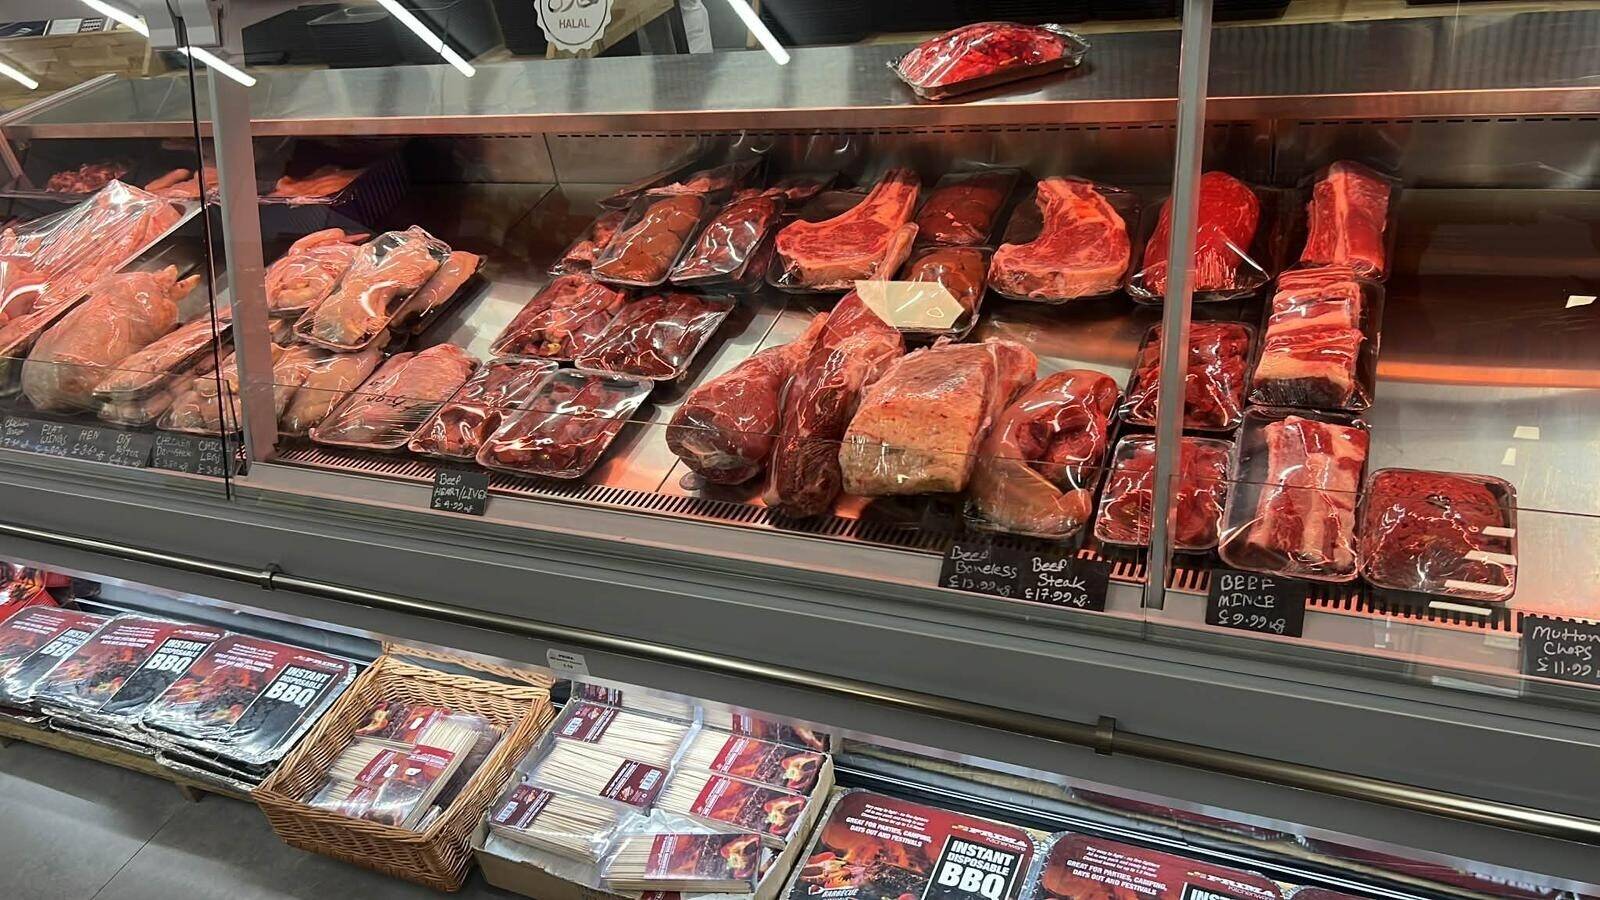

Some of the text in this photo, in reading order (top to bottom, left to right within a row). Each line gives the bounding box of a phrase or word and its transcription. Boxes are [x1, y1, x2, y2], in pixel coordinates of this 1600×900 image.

[560, 18, 590, 28] HALAL
[439, 473, 462, 485] Beef
[950, 545, 990, 561] Beef
[956, 560, 1018, 579] Boneless
[1032, 557, 1067, 573] Beef
[1037, 573, 1086, 592] Steak
[1220, 574, 1276, 591] BEEF
[1218, 593, 1275, 608] MINCE
[1532, 625, 1600, 643] Mutton
[164, 639, 208, 651] INSTANT
[1543, 641, 1592, 661] Chops
[144, 653, 193, 675] BBQ
[284, 666, 332, 682] INSTANT
[264, 681, 317, 708] BBQ
[846, 817, 865, 826] GREAT
[865, 820, 877, 829] FOR
[850, 824, 866, 833] DAYS
[877, 831, 891, 840] AND
[891, 835, 923, 848] FESTIVALS
[951, 840, 1015, 866] INSTANT
[946, 851, 1011, 876] DISPOSABLE
[1067, 859, 1089, 870] GREAT
[1089, 865, 1103, 873] FOR
[938, 861, 1005, 900] BBQ
[1072, 869, 1157, 896] DAYS OUT AND FESTIVALS
